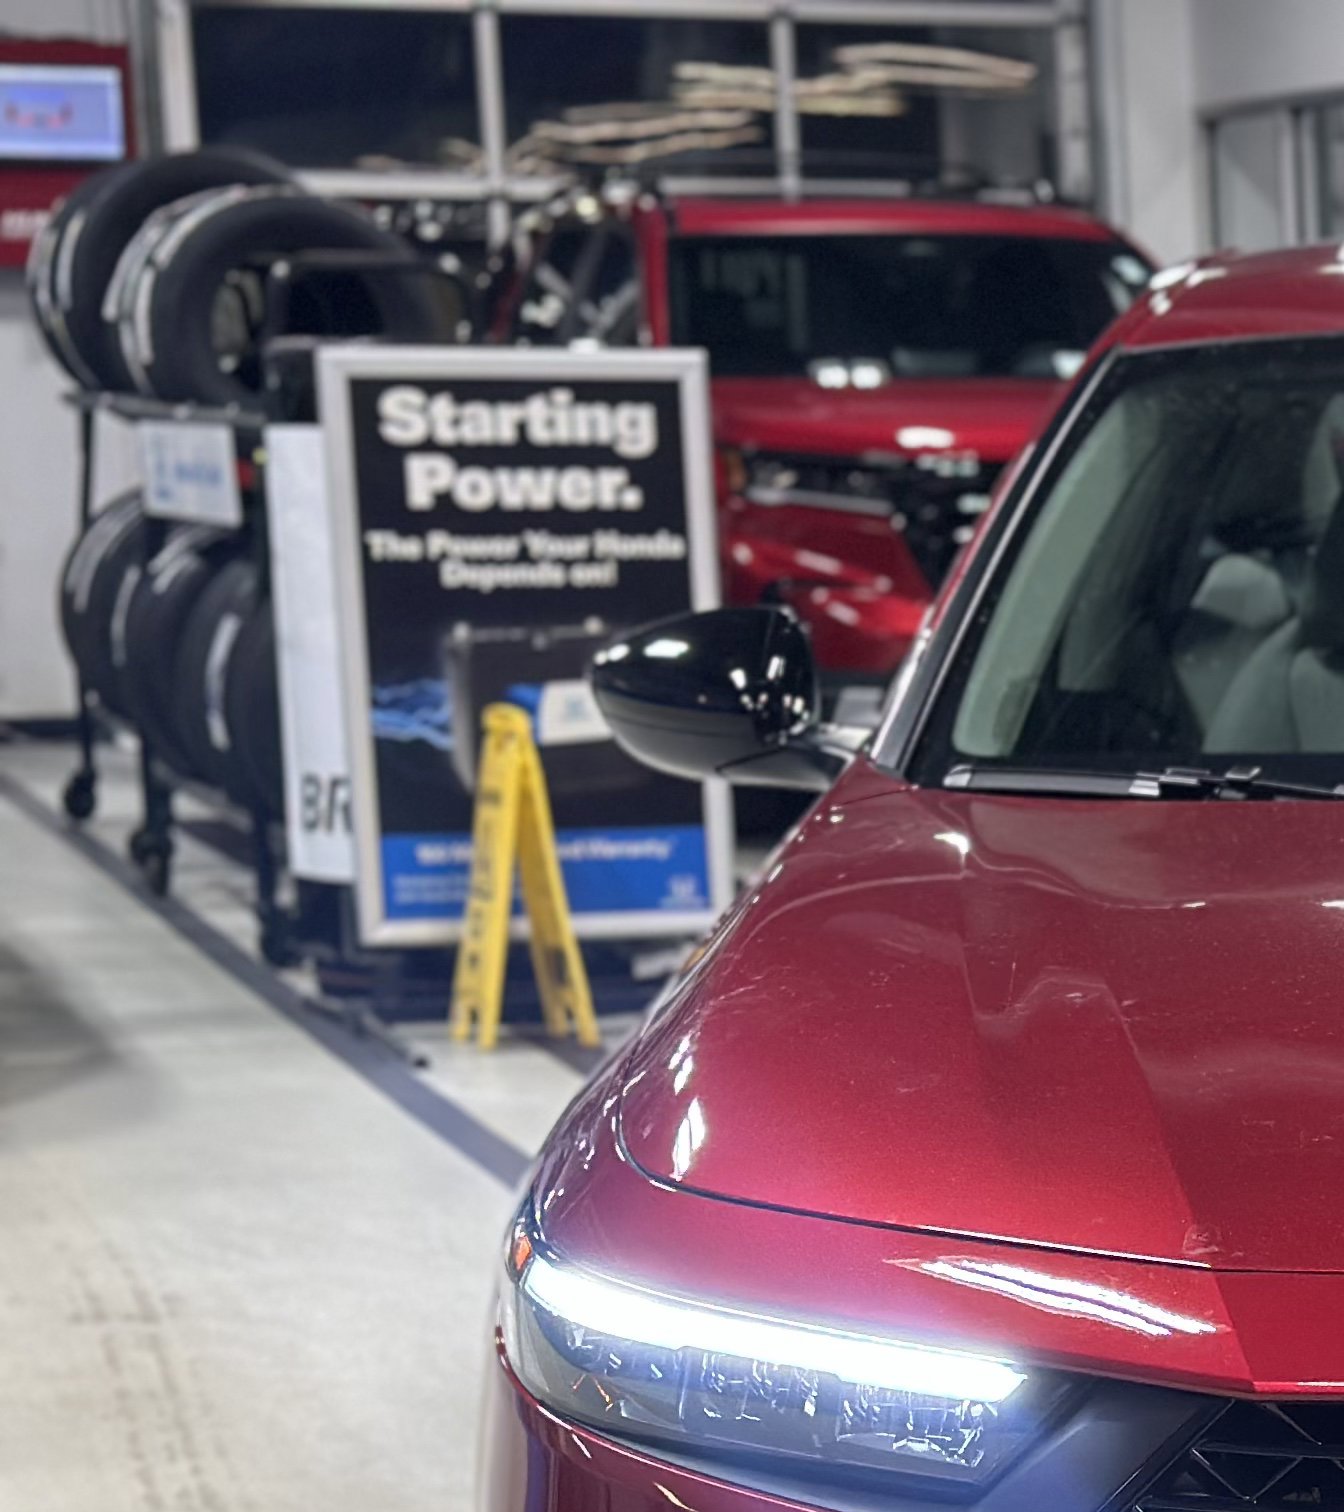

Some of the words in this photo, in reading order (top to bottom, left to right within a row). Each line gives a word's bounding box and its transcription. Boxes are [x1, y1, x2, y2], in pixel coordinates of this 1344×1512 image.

[379, 387, 659, 458] Starting
[404, 453, 644, 511] Power.
[366, 528, 424, 562] The
[426, 528, 520, 561] Power
[522, 528, 590, 560] Your
[593, 528, 687, 560] Honda
[440, 558, 566, 593] Depends
